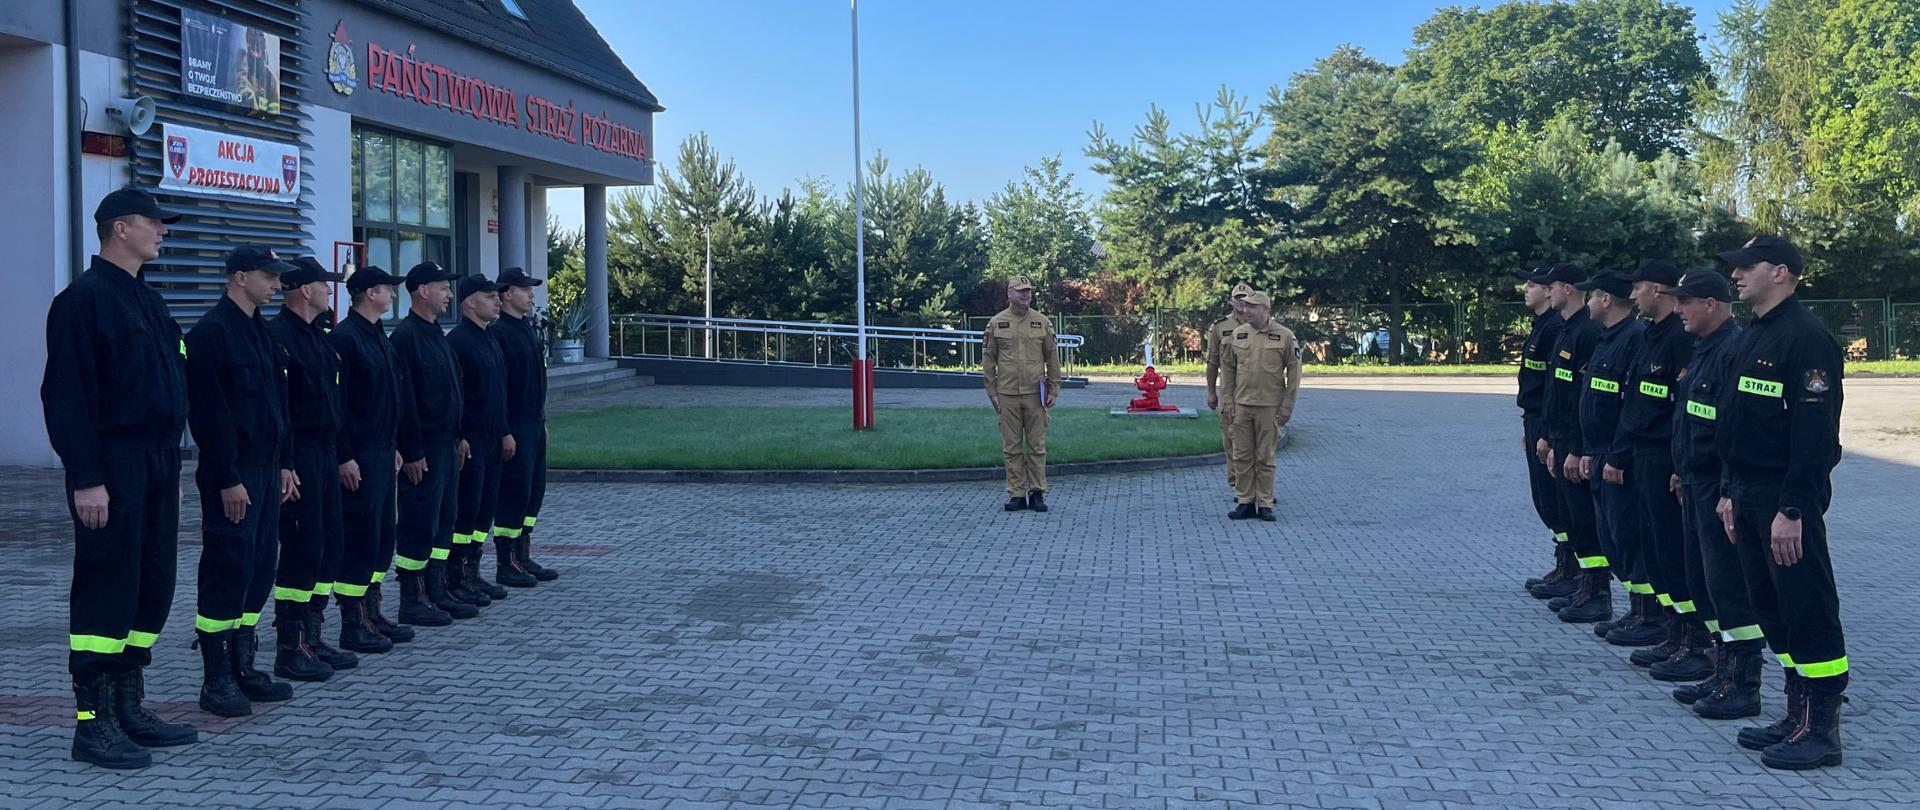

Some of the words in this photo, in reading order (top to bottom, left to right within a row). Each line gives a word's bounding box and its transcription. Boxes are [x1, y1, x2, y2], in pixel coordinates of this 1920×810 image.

[188, 57, 212, 70] DBAMY
[188, 70, 194, 79] O
[195, 71, 216, 84] TWOJE
[188, 83, 242, 103] BEZPIECZEŃSTWO
[368, 42, 519, 129] PAŃSTWOWA
[526, 94, 577, 144] STRAŻ
[581, 109, 647, 161] POŻARNA
[217, 140, 255, 163] AKCJA
[187, 166, 280, 194] PROTESTACYJNA
